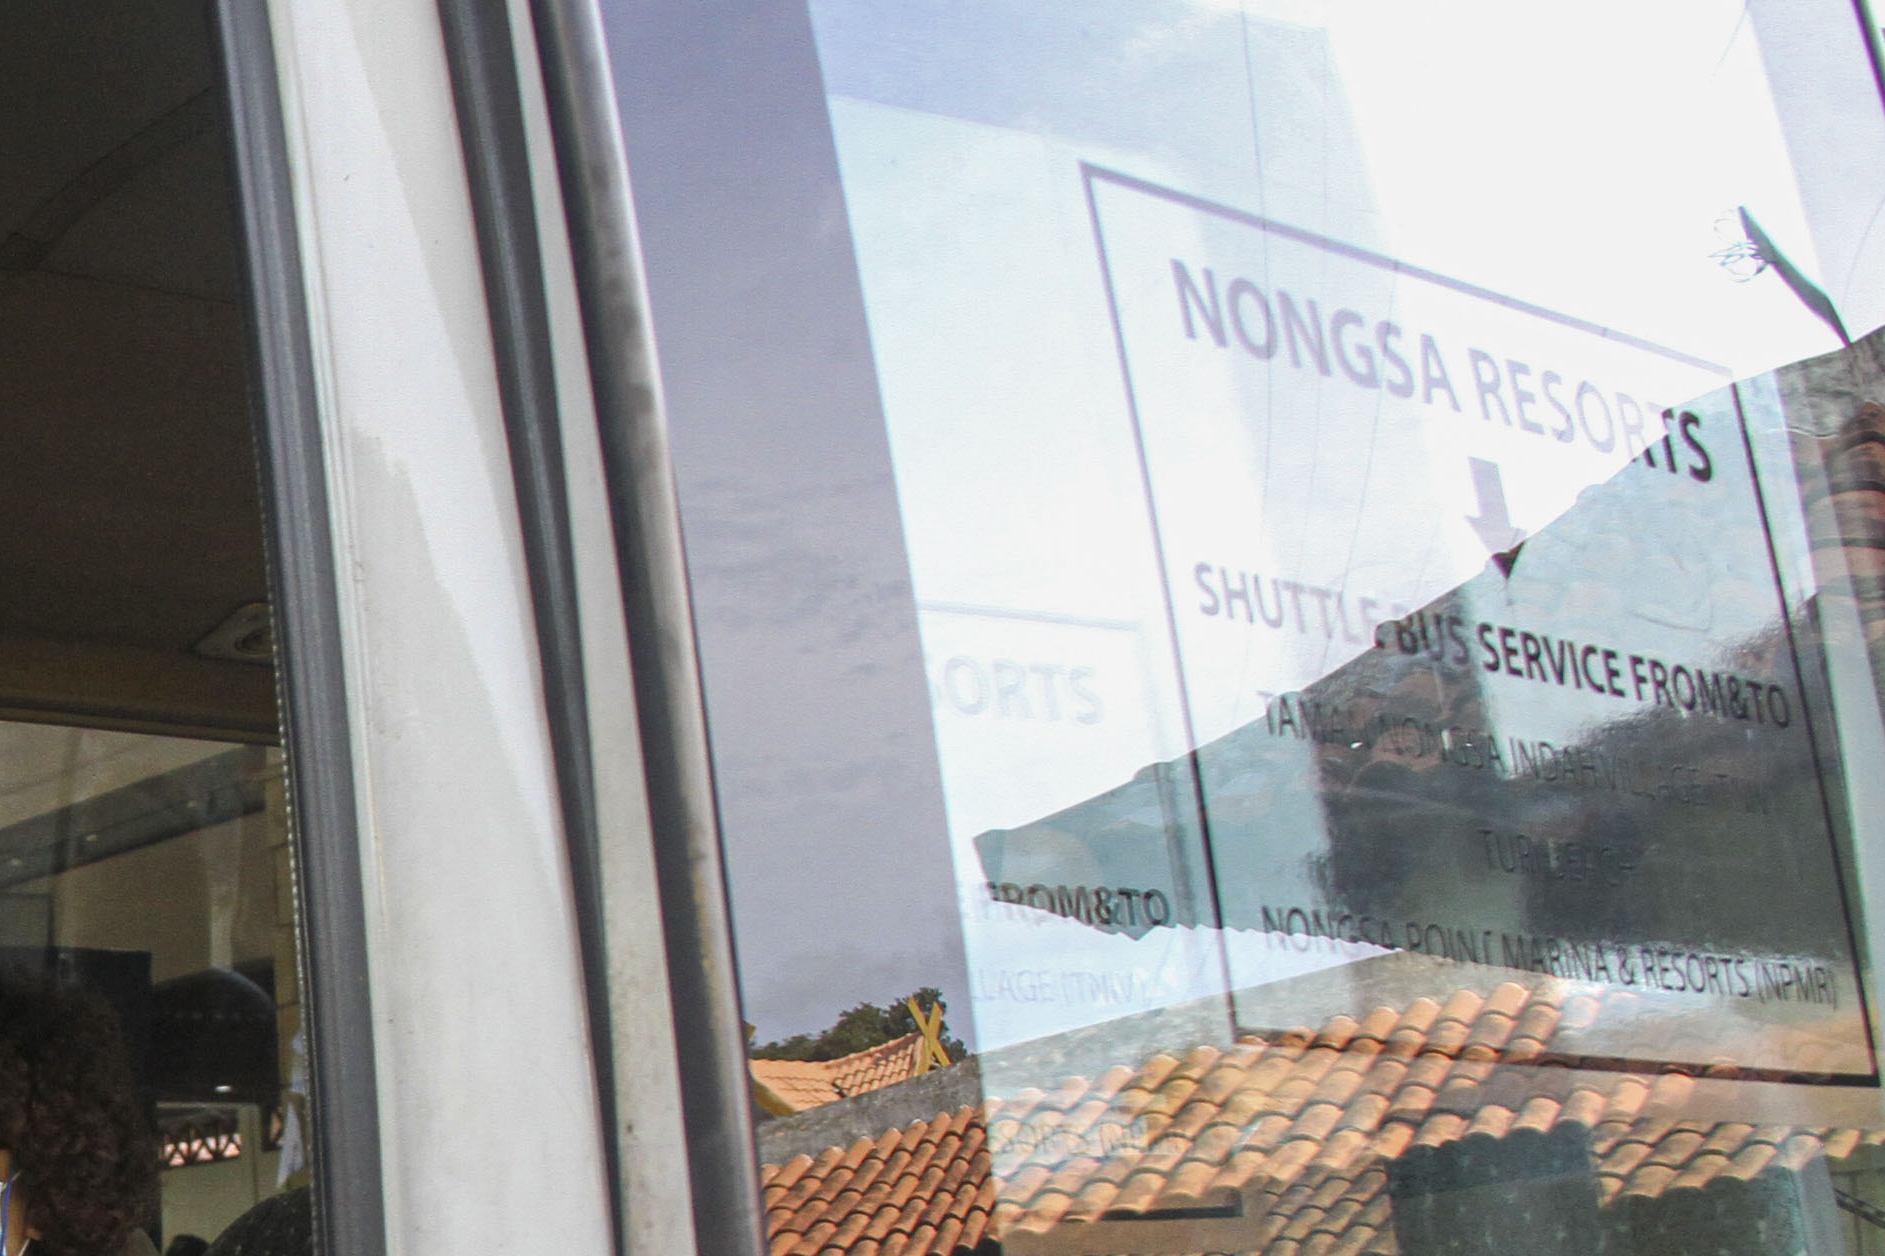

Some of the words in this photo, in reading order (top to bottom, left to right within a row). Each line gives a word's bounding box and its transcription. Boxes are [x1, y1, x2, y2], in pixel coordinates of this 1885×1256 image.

[1168, 257, 1463, 414] NONGSA
[1467, 346, 1714, 484] RESORTS
[1192, 560, 1387, 650] SHUTTLE
[1392, 604, 1471, 666] BUS
[1477, 620, 1628, 699] SERVICE
[1628, 653, 1792, 730] FROM&TO
[1640, 947, 1751, 998] RESORTS
